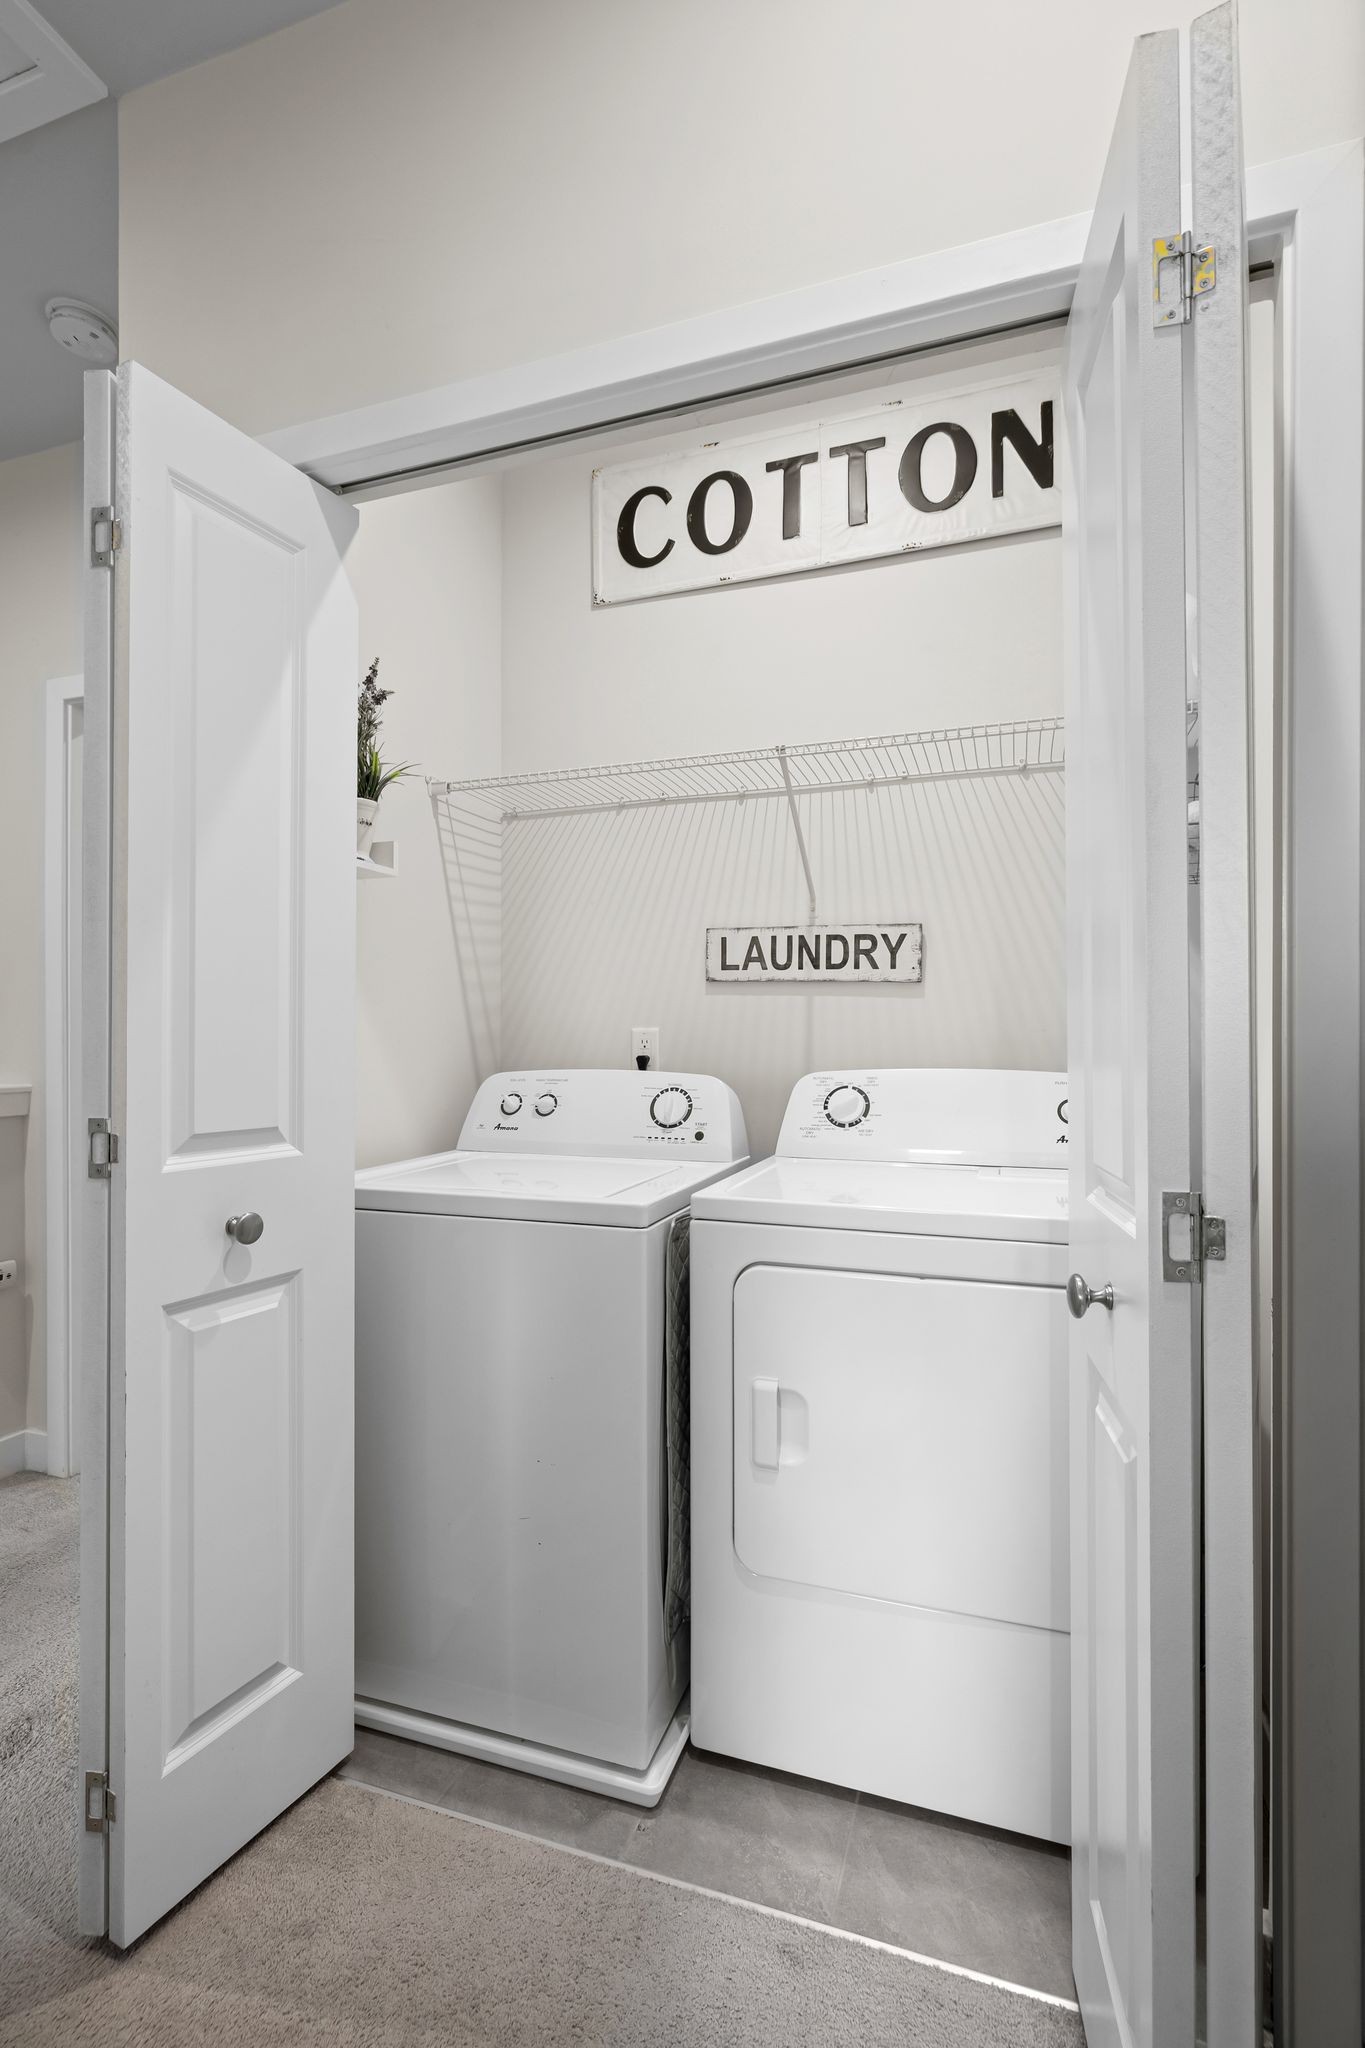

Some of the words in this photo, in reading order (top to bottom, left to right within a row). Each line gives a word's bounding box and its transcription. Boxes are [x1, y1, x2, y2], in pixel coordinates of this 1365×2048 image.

[617, 400, 1054, 569] COTTON
[720, 933, 908, 971] LAUNDRY
[493, 1123, 519, 1131] Amana
